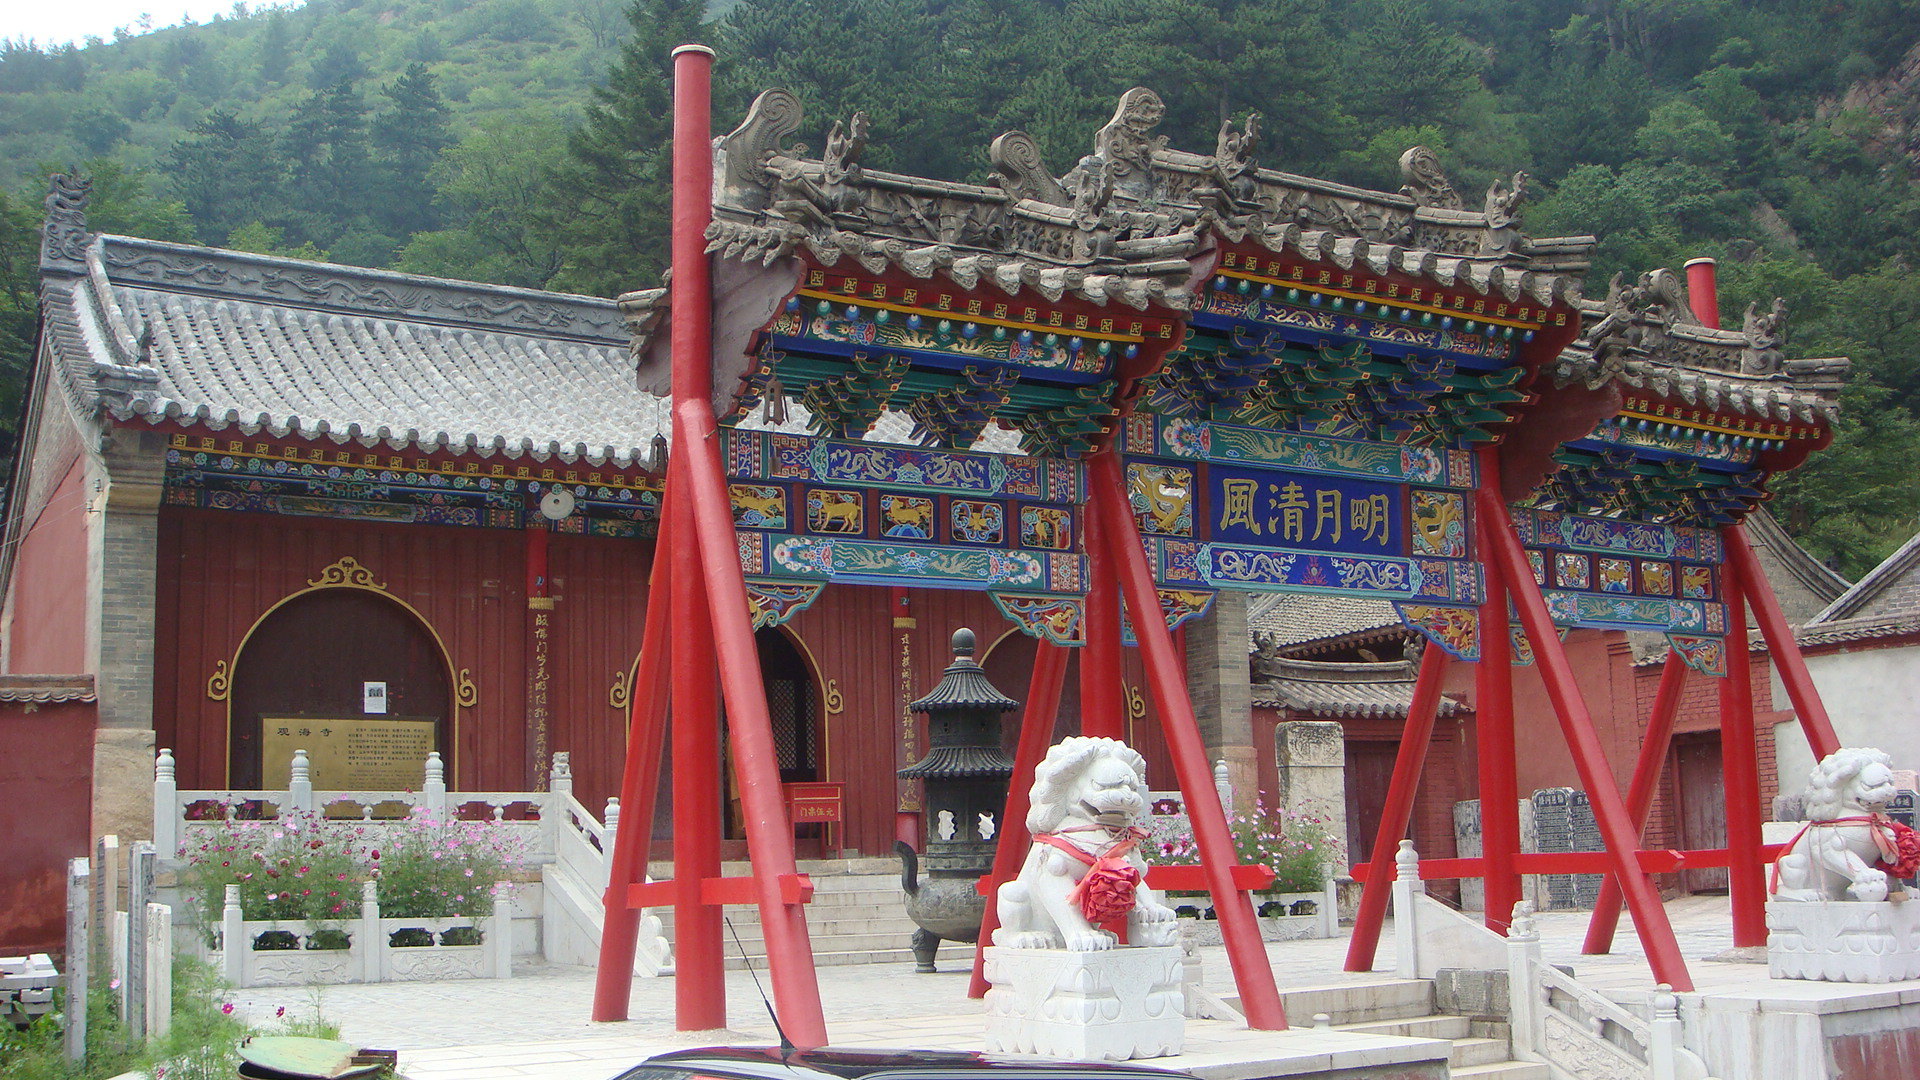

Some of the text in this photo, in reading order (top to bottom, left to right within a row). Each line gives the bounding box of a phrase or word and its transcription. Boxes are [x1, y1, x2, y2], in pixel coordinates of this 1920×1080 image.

[277, 727, 333, 738] 观海寺
[800, 806, 835, 817] 门票伍元
